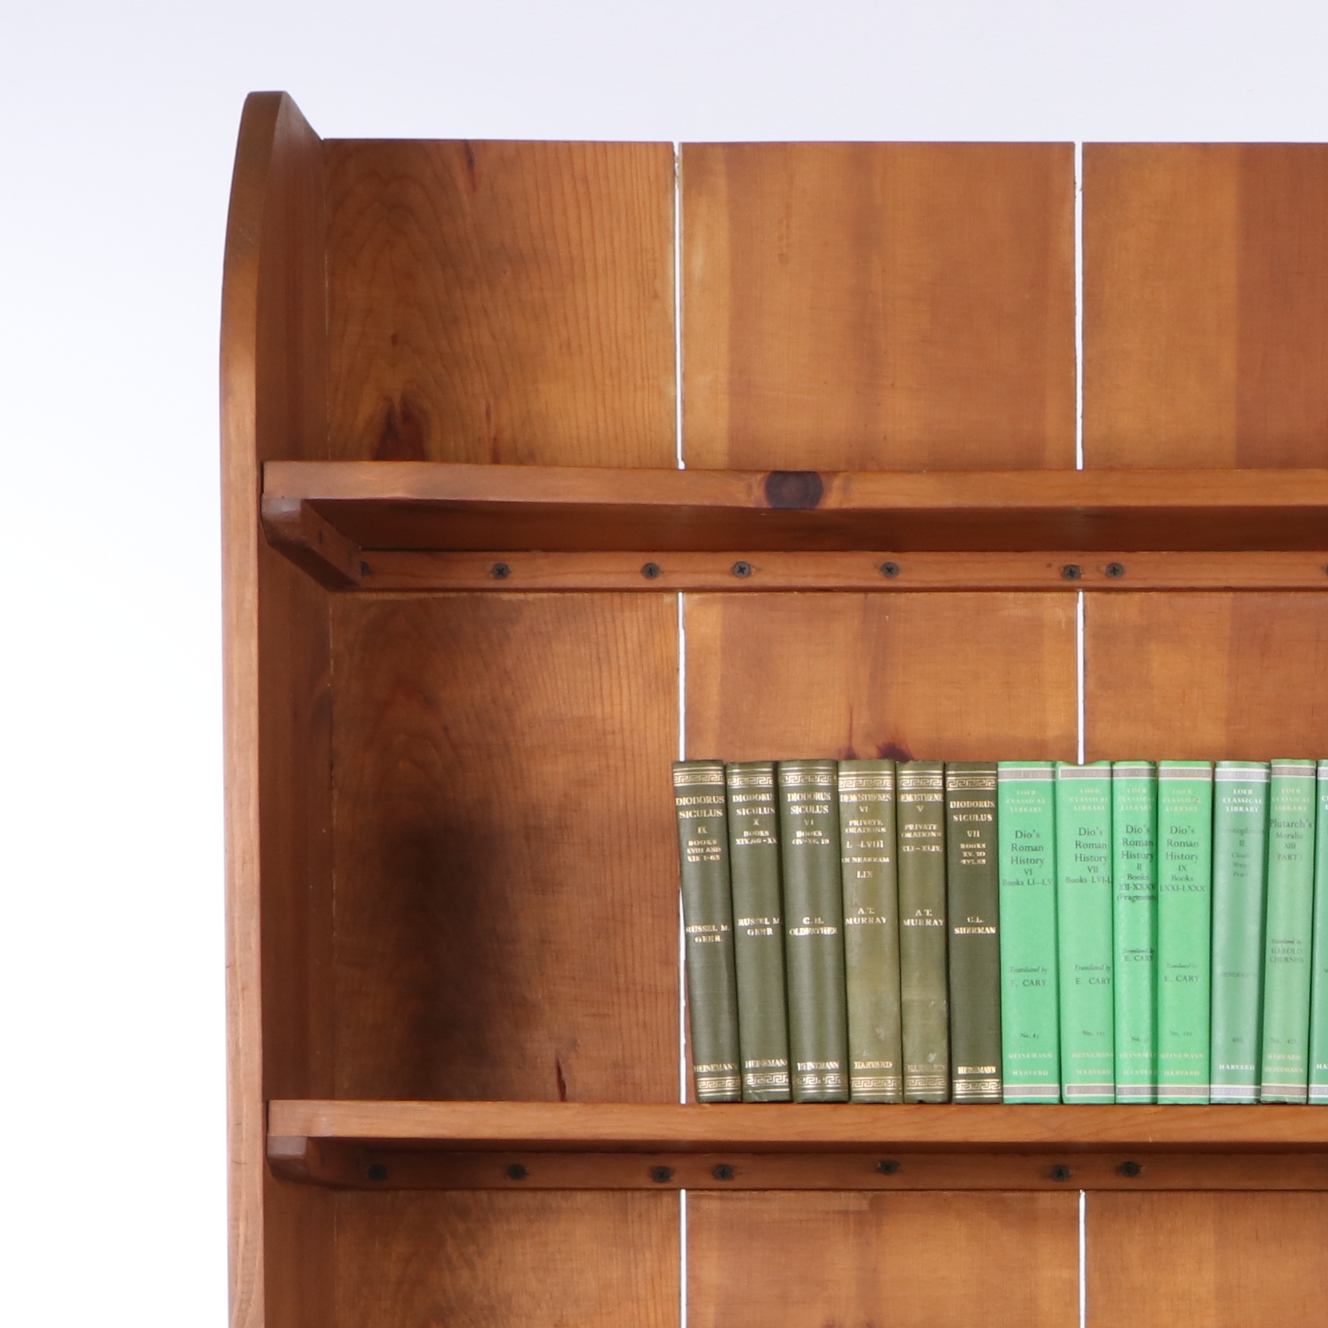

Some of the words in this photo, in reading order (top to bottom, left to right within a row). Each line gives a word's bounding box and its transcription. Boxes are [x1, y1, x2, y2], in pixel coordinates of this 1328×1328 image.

[676, 796, 724, 806] DIODORUS
[787, 792, 831, 803] DIODORUS
[790, 804, 829, 815] SICULUS
[949, 800, 996, 809] DIODORUS
[679, 809, 723, 819] SICULUS
[952, 814, 993, 823] SICULUS
[1014, 829, 1041, 839] Dio's
[1078, 827, 1104, 837] Dio's
[1125, 824, 1150, 834] Dio's
[1170, 825, 1195, 835] Dio's
[1011, 844, 1044, 852] Roman
[1075, 841, 1107, 851] Roman
[1122, 838, 1154, 848] Roman
[1166, 839, 1199, 848] Roman
[1074, 854, 1108, 866] History
[1121, 850, 1154, 862] History
[1165, 852, 1199, 863] History
[1011, 856, 1044, 868] History
[845, 916, 888, 925] MURRAY
[903, 918, 944, 927] MURRAY
[1022, 979, 1046, 987] CARY
[1088, 977, 1111, 985] CARY
[1219, 1063, 1255, 1071] HARVARD
